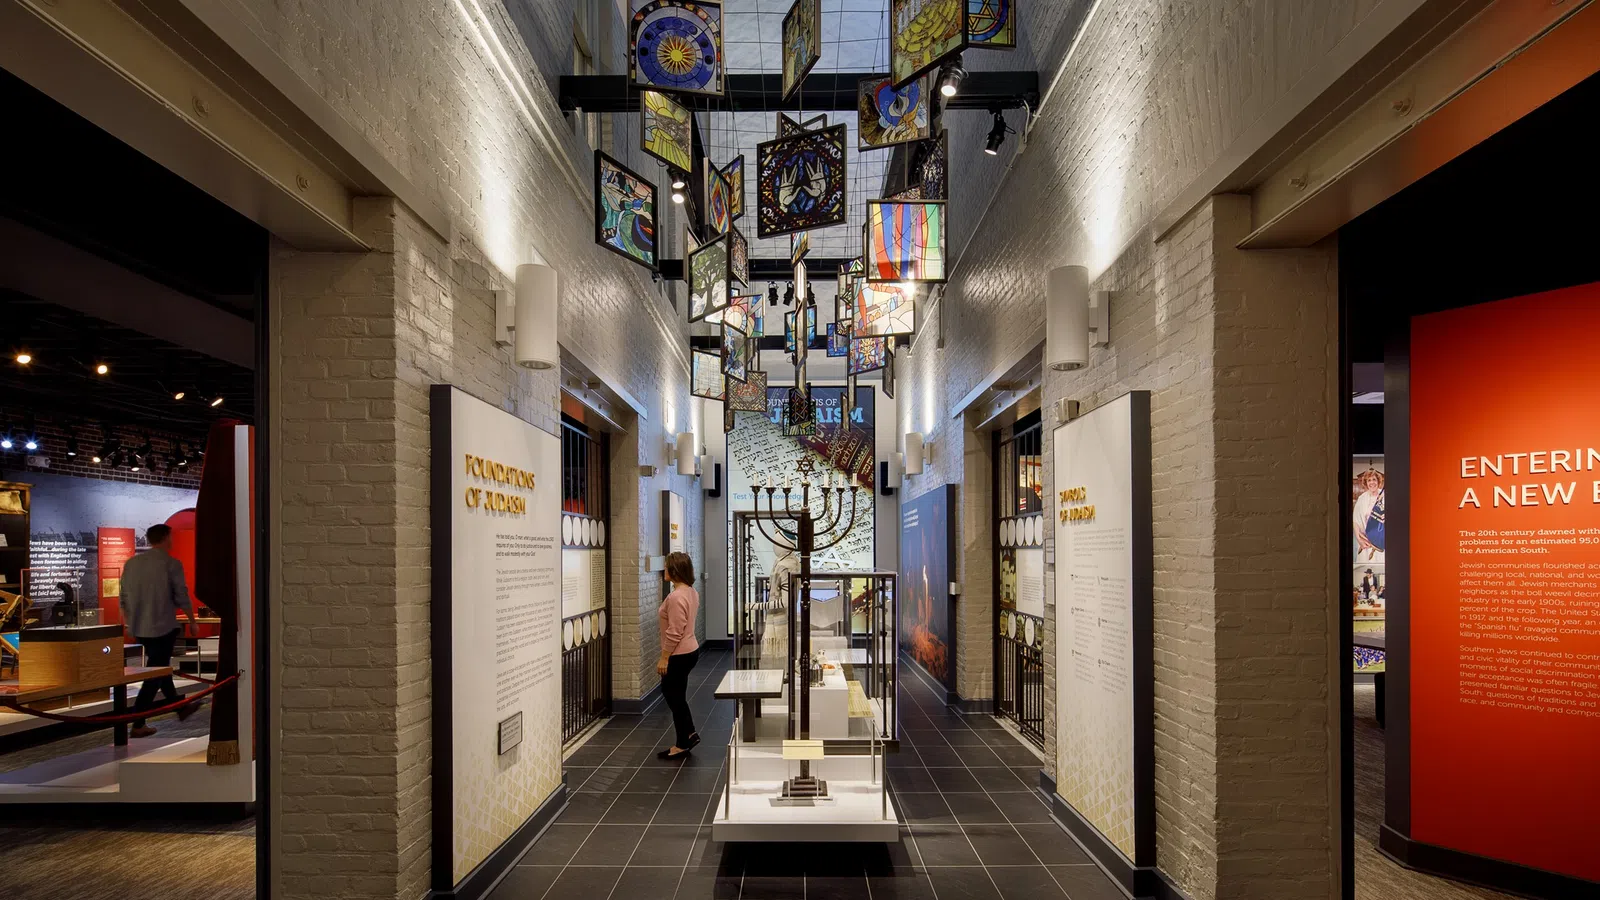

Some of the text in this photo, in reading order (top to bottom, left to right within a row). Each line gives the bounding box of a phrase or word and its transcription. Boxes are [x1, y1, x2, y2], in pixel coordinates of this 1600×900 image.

[770, 407, 863, 423] JAISM
[1460, 448, 1600, 478] ENTERIN
[465, 454, 535, 490] FOUNDATIONS
[465, 487, 526, 515] OF JUDAISM
[768, 493, 804, 502] nowedg
[1458, 487, 1481, 509] A
[1493, 482, 1577, 508] NEW
[1522, 616, 1559, 625] following
[1460, 631, 1480, 639] killing
[1460, 645, 1494, 653] Southern
[1520, 650, 1562, 658] continued
[1496, 657, 1520, 665] vitality
[1536, 669, 1595, 679] discrimination
[1479, 674, 1524, 682] acceptance
[1571, 681, 1599, 689] fragile.
[1500, 683, 1528, 691] familiar
[1531, 687, 1571, 696] questions
[1486, 692, 1524, 700] questions
[1538, 696, 1576, 706] traditions
[1497, 702, 1544, 712] community
